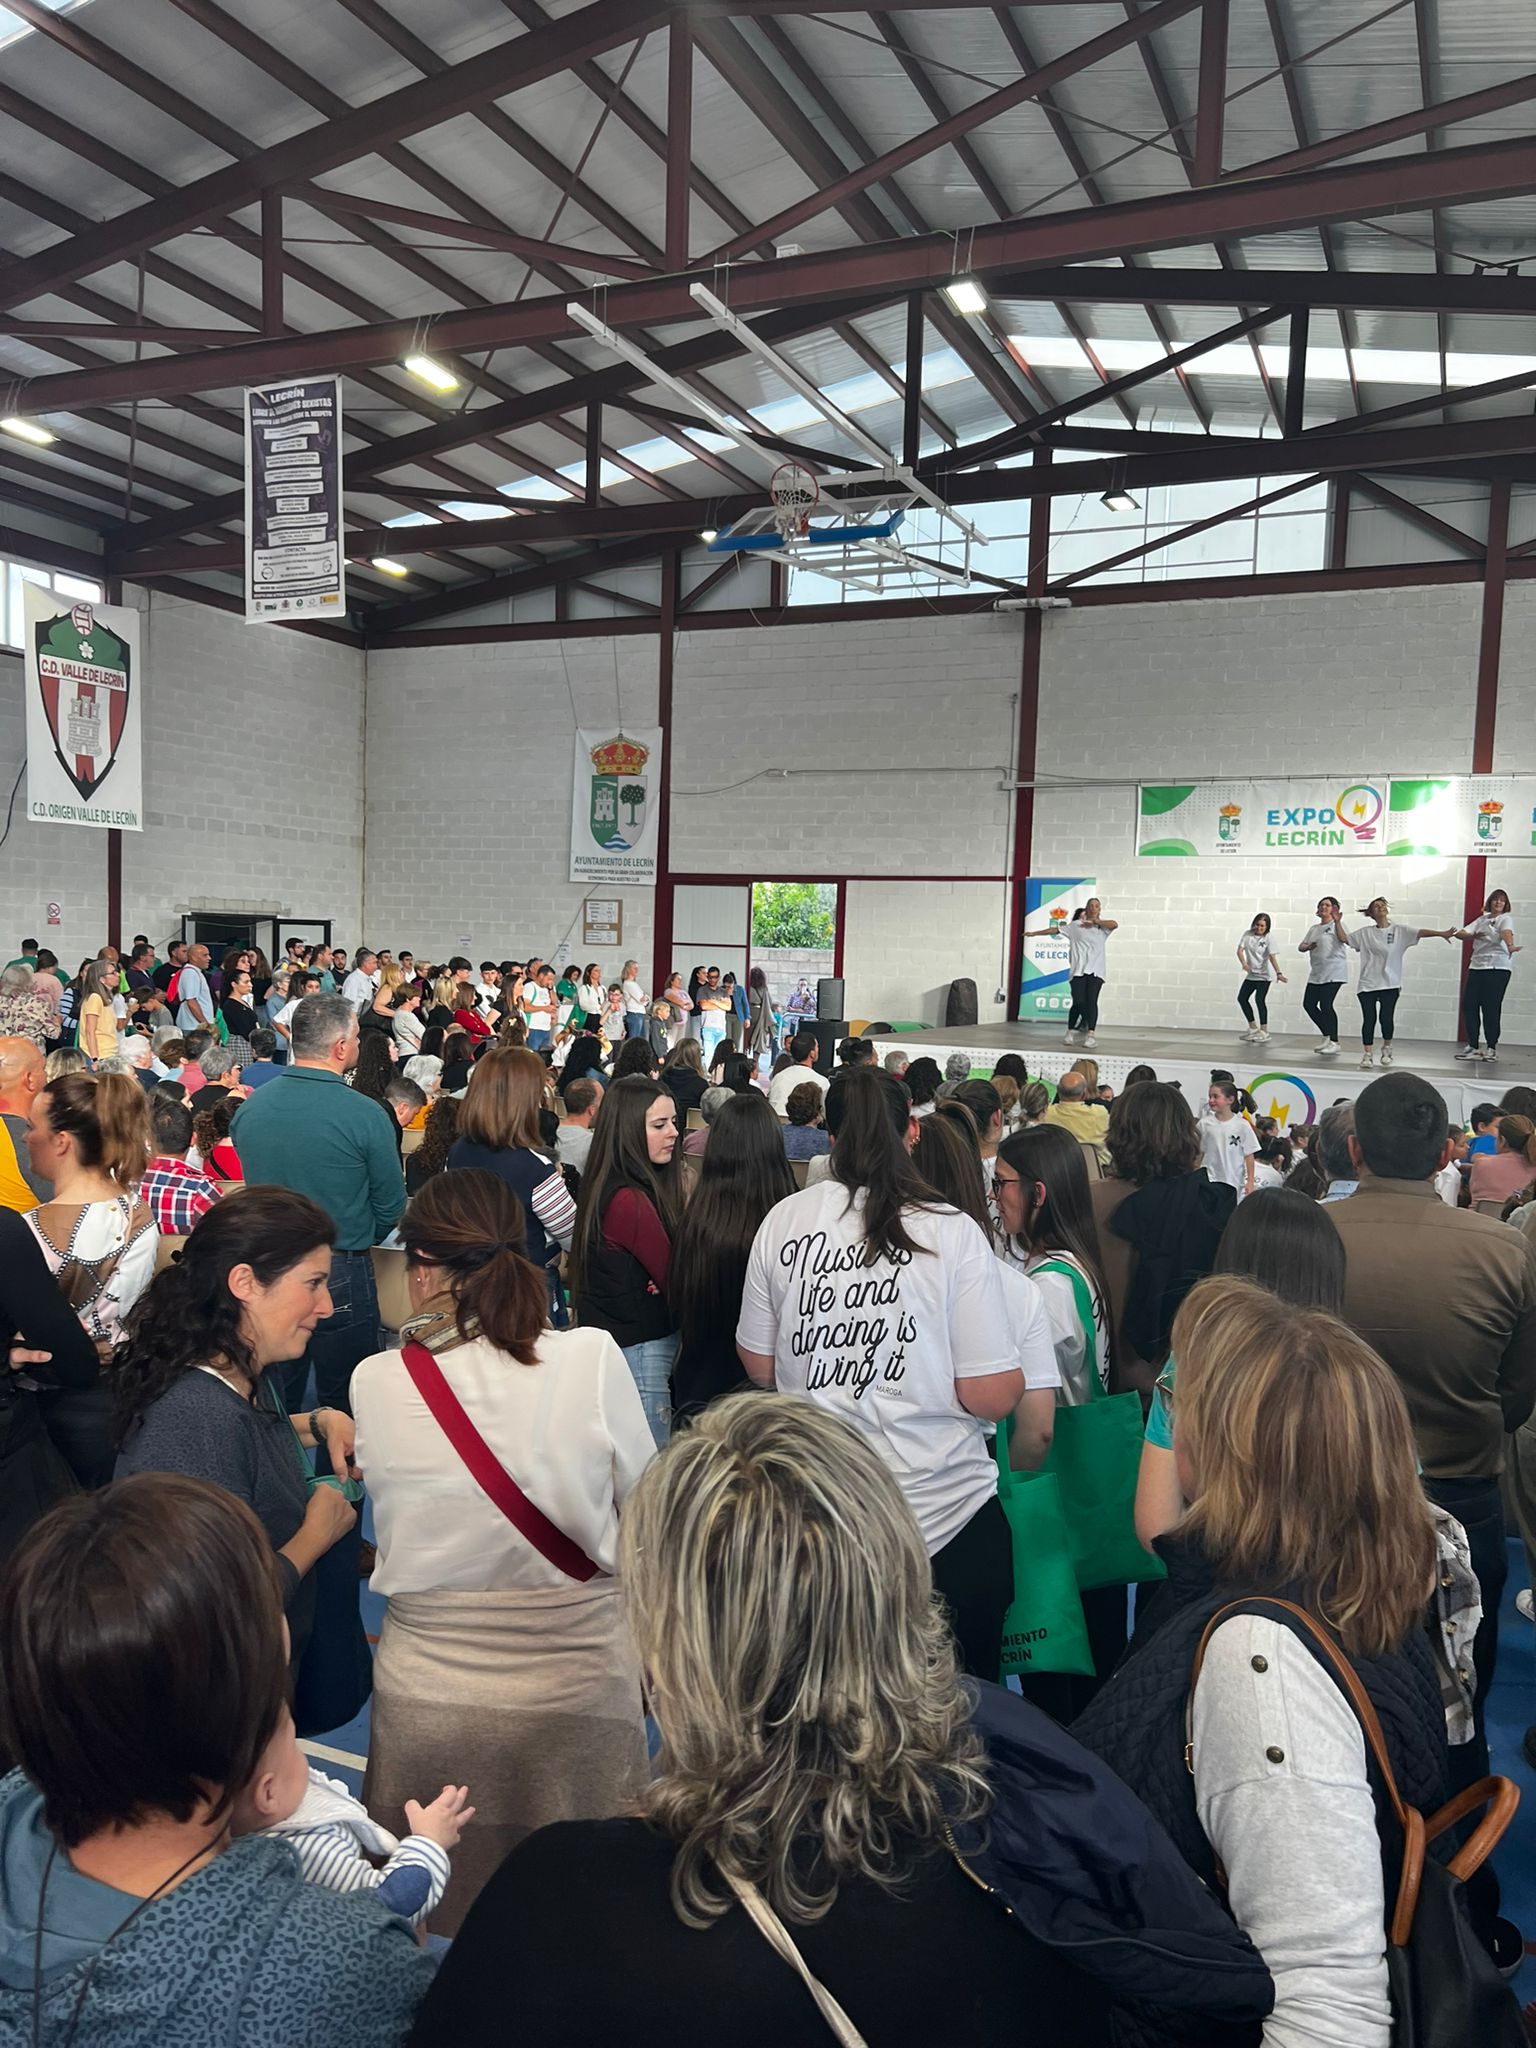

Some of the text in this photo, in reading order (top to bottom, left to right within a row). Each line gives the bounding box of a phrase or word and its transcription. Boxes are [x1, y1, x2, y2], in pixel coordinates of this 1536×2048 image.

[270, 387, 305, 403] LECRÍN
[41, 659, 124, 688] C.D. VALLE DE LECRÍN
[32, 802, 137, 826] C.D. ORIGEN VALLE DE LECRÍN
[1267, 807, 1336, 826] EXPO
[1265, 826, 1345, 846] LECRÍN
[574, 856, 654, 868] AYUNTAMIENTO DE LECRÍN
[1035, 951, 1045, 959] DE
[799, 1267, 900, 1322] life and
[897, 1311, 917, 1343] is
[806, 1345, 905, 1400] living it
